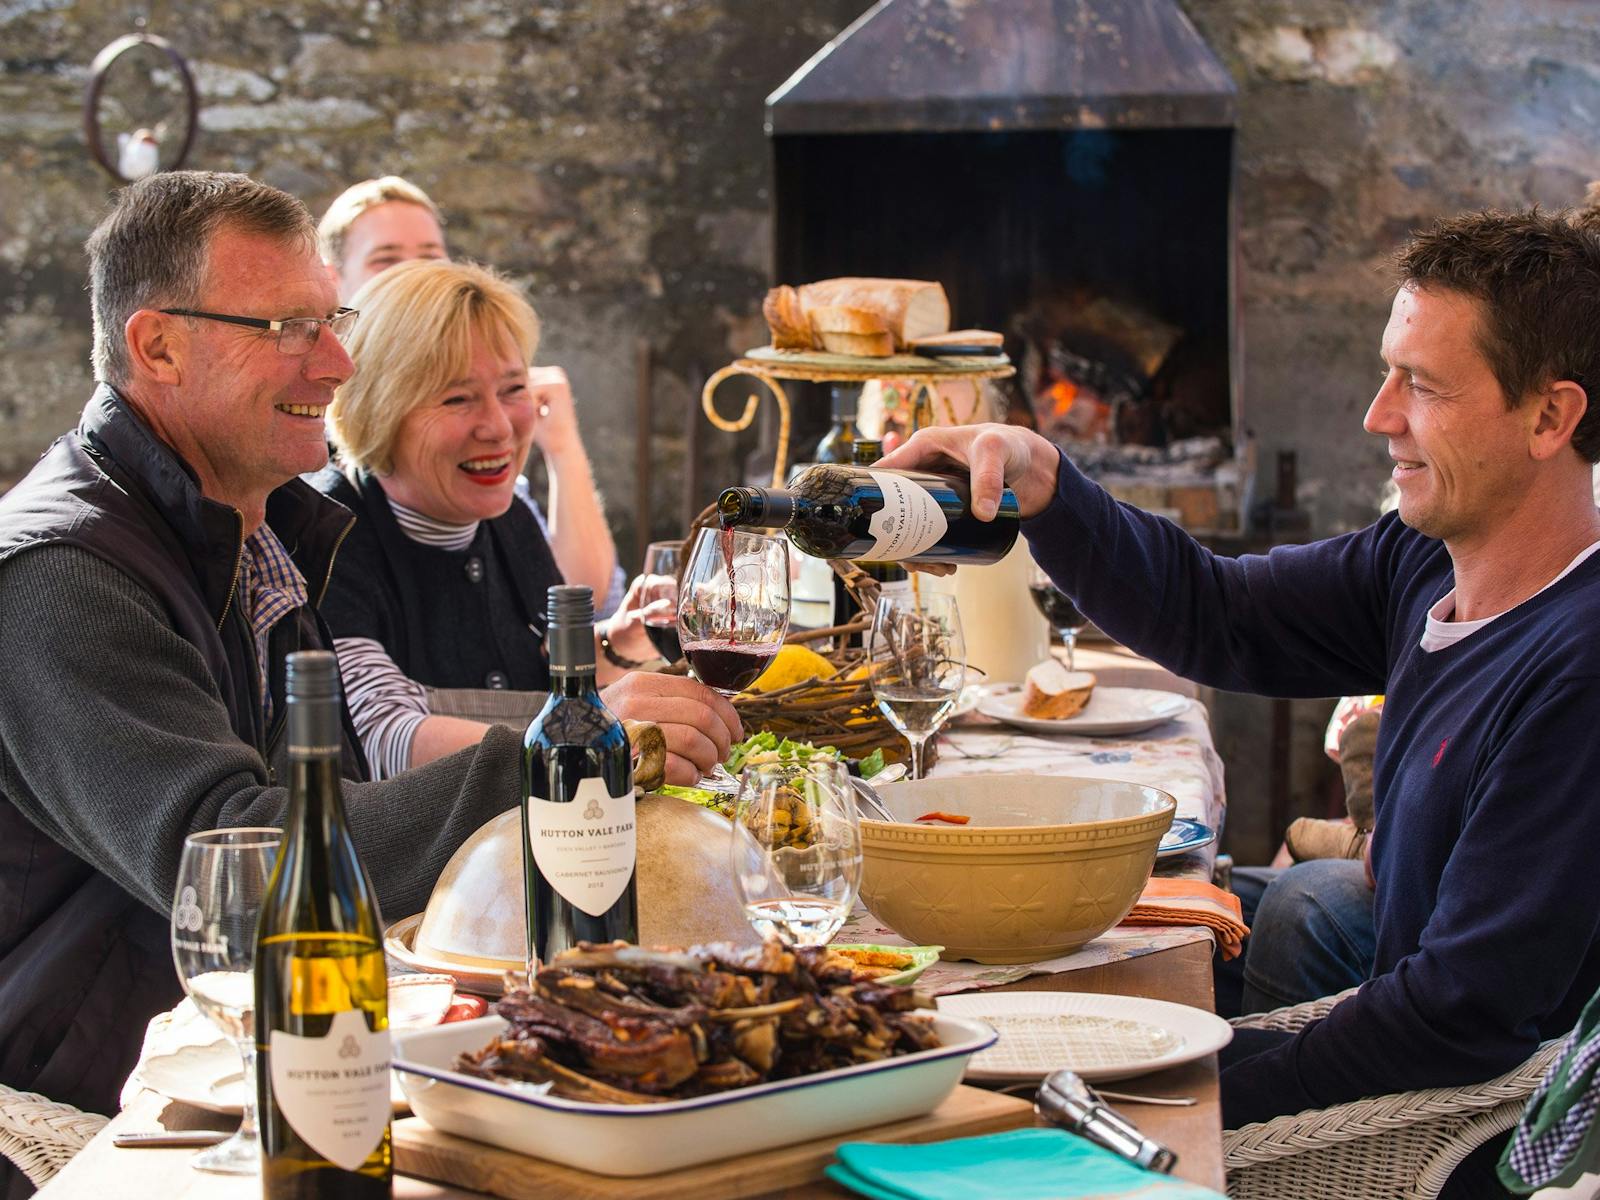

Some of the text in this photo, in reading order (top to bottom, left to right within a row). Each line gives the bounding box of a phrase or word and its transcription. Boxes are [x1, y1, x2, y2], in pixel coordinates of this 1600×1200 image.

[897, 507, 906, 531] VALE
[541, 829, 584, 838] HUTTON
[587, 827, 615, 837] VALE
[555, 870, 593, 879] CABERNET
[286, 1069, 340, 1080] HUTTON
